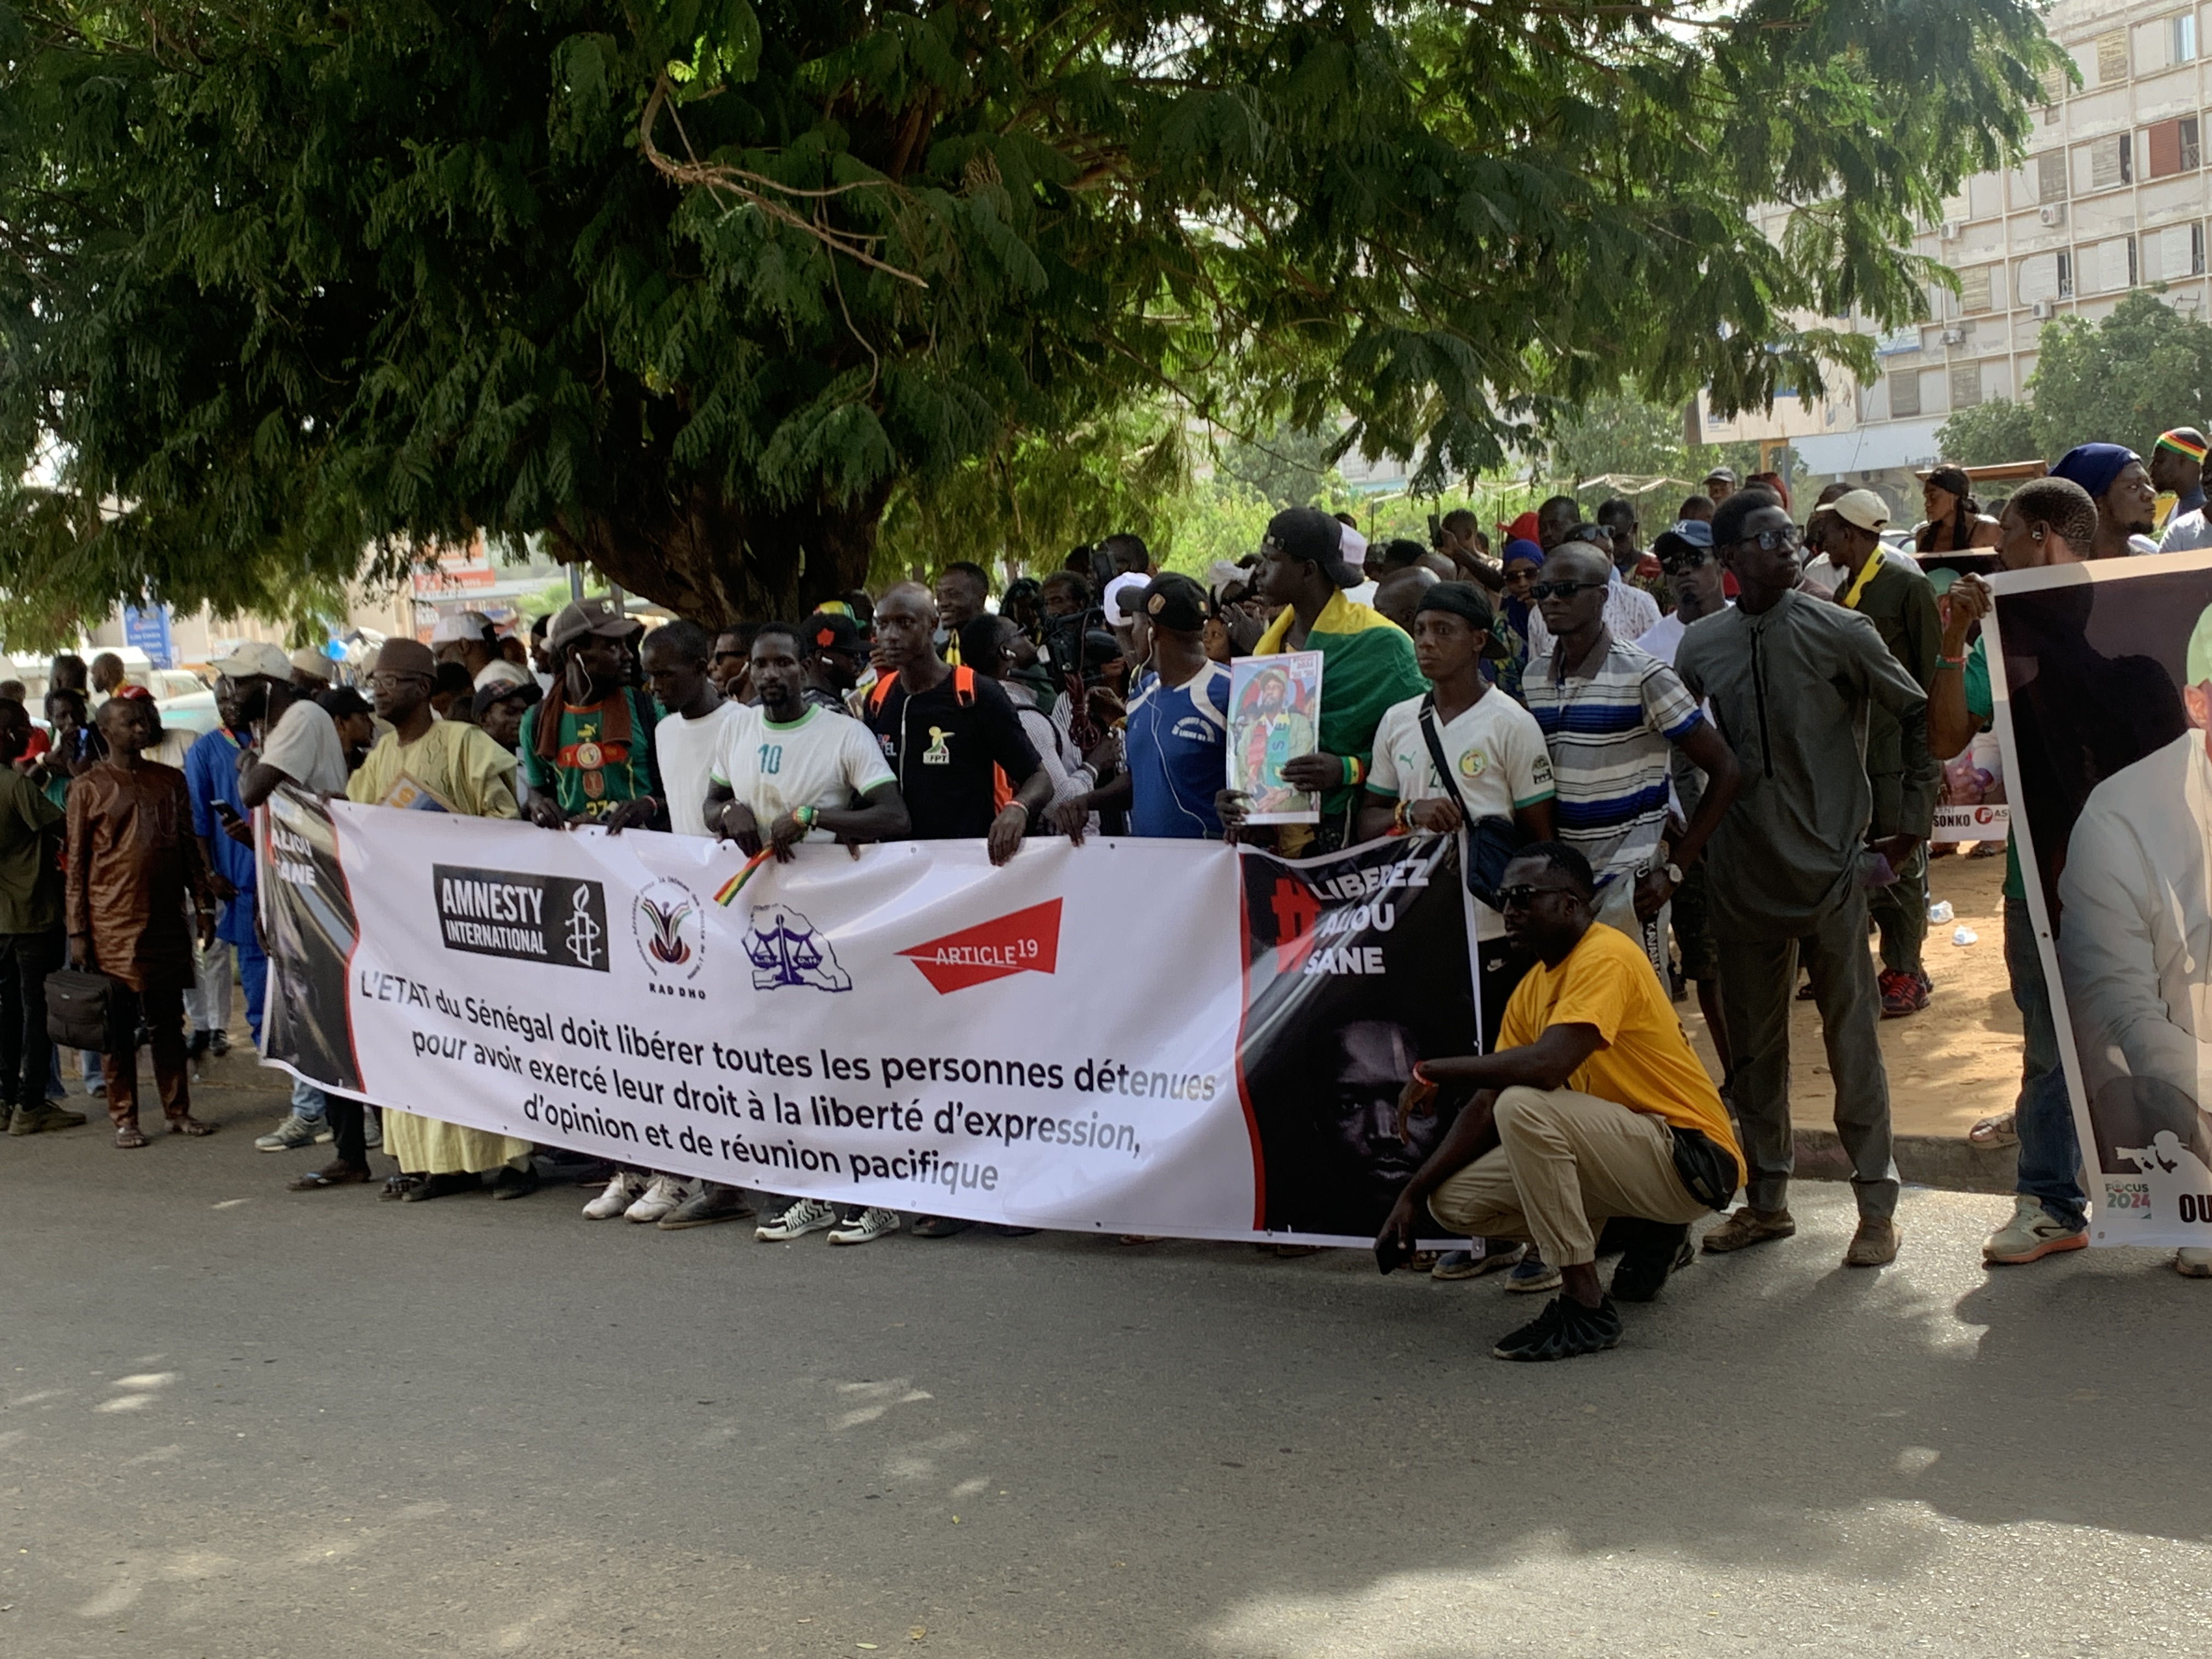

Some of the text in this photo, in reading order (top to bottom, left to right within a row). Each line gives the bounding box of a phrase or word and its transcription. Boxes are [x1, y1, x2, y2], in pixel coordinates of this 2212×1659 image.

[758, 743, 782, 775] 10
[1933, 815, 1971, 827] SONKO
[442, 878, 544, 925] AMNESTY
[445, 919, 548, 955] INTERNATIONAL
[1304, 946, 1386, 974] SANE
[435, 989, 462, 1019] du
[465, 996, 554, 1043] Sénégal
[561, 1017, 611, 1053] doit
[616, 1024, 704, 1066] libérer
[712, 1042, 812, 1078] toutes
[820, 1048, 871, 1080] les
[881, 1056, 1064, 1090] personnes
[1074, 1058, 1216, 1103] détenues
[412, 1029, 467, 1060] pour
[473, 1045, 523, 1075] avoir
[529, 1058, 608, 1094] exercé
[612, 1069, 664, 1105] leur
[673, 1080, 741, 1118] droit
[747, 1089, 765, 1121] à
[773, 1092, 802, 1125] la
[810, 1094, 923, 1132] liberté
[645, 1123, 674, 1150] et
[679, 1125, 713, 1157] de
[720, 1133, 841, 1173] réunion
[848, 1148, 998, 1195] pacifique
[2107, 1192, 2151, 1209] 2024
